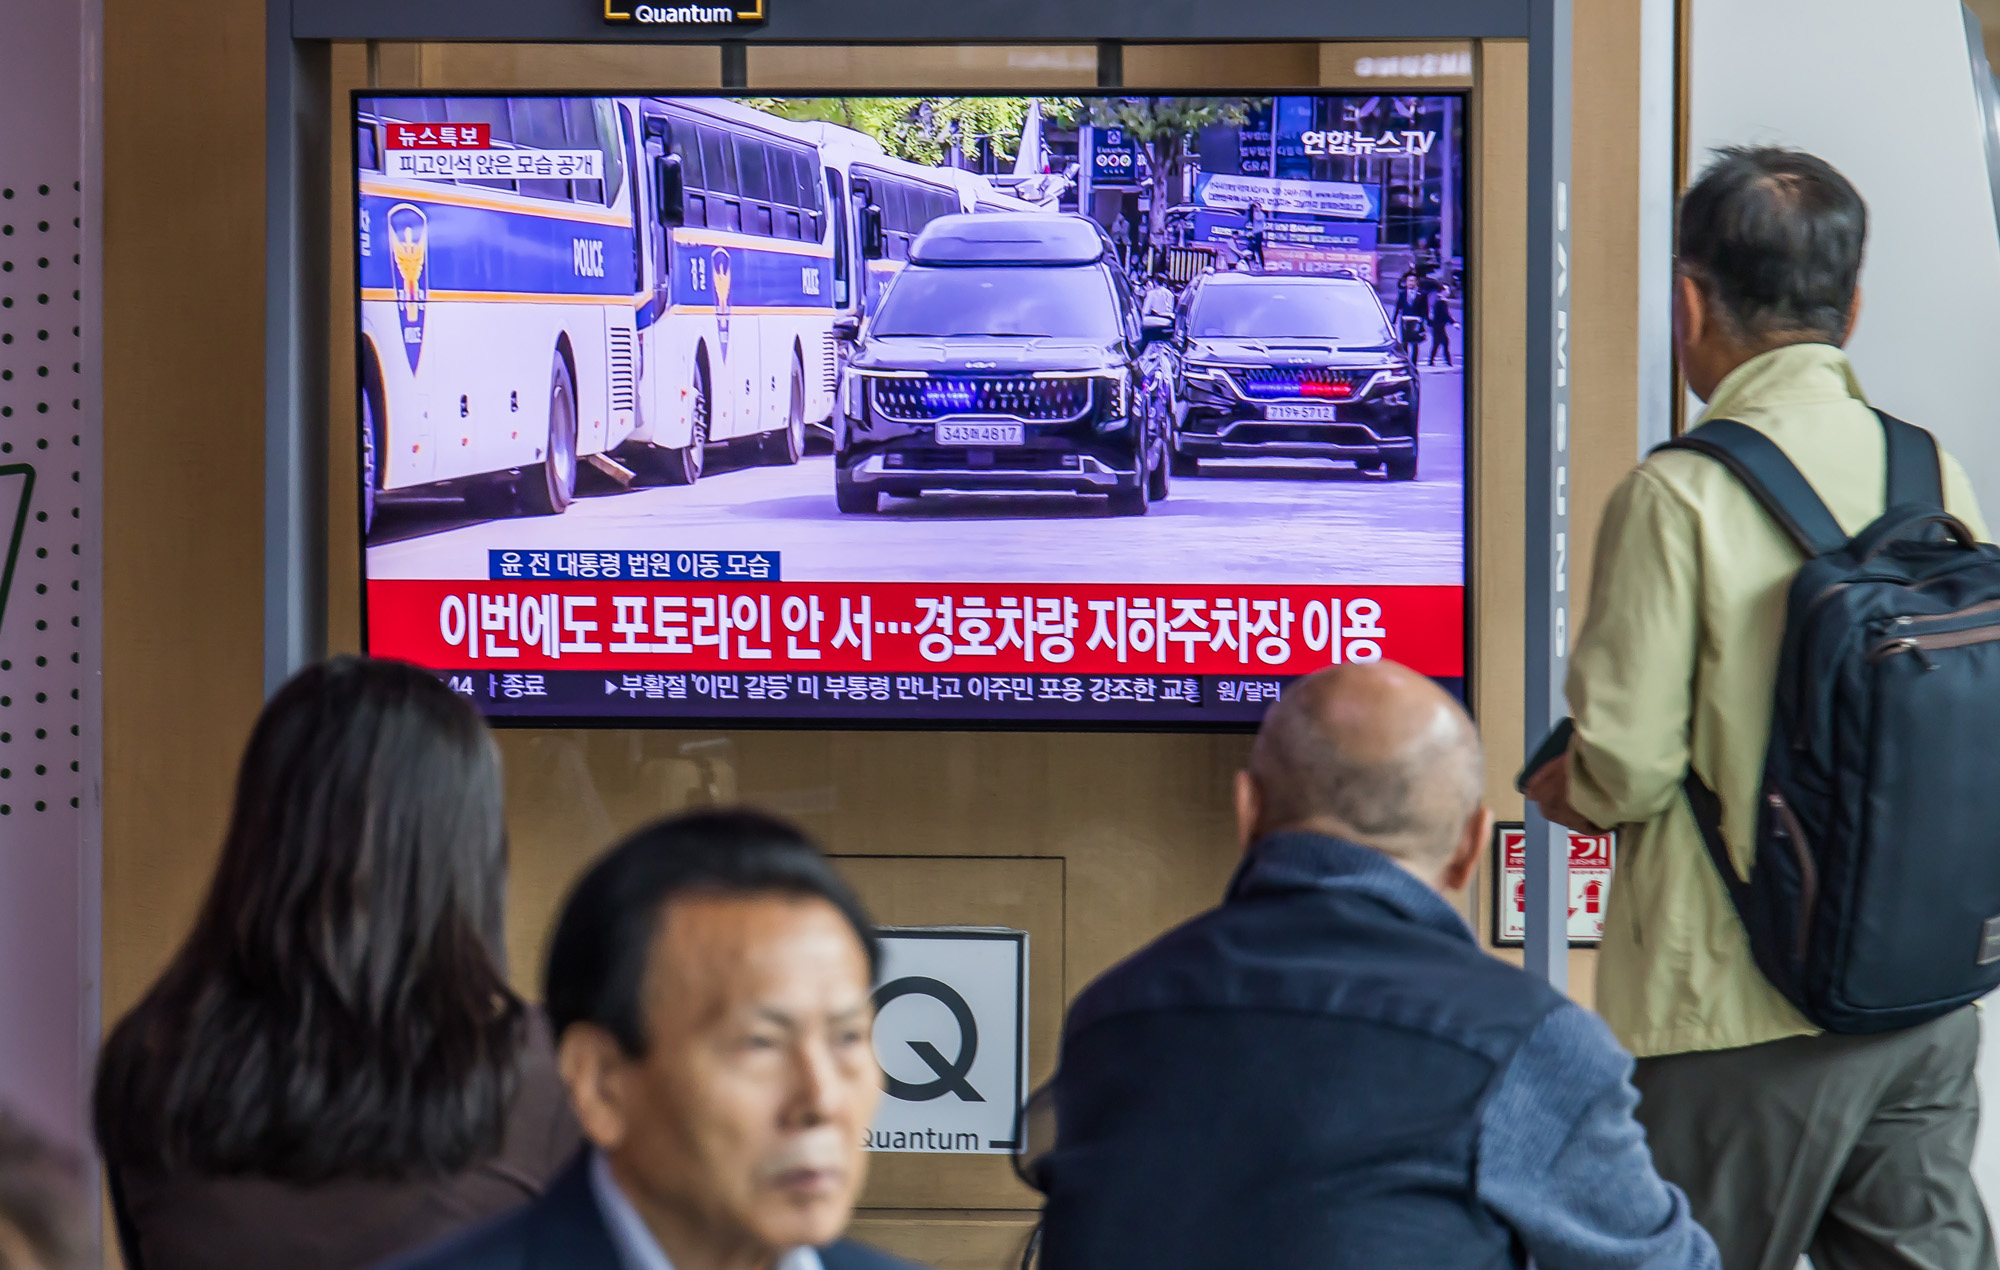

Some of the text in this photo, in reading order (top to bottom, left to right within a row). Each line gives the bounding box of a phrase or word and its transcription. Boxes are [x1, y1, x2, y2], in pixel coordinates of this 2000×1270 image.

[635, 4, 732, 23] Quantum
[398, 127, 480, 147] 뉴스특보
[1301, 130, 1437, 156] 연합뉴스TV
[399, 154, 594, 177] 피고인석 앉은 모습 공개
[573, 238, 605, 277] POLICE
[1556, 180, 1568, 658] SAMSUNG
[499, 552, 771, 579] 윤 전 대통령 법원 이동 모습
[439, 592, 603, 660] 이번에도
[609, 594, 772, 661] 포토라인
[781, 595, 825, 661] 안
[1085, 596, 1295, 665] 지하주차장
[1302, 598, 1386, 665] 이용
[501, 673, 548, 699] 종료
[620, 674, 687, 700] 부활절
[797, 675, 819, 701] 미
[823, 675, 890, 702] 부통령
[896, 676, 964, 702] 만나고
[967, 676, 1034, 703] 이주민
[1037, 677, 1084, 703] 포용
[1089, 678, 1156, 703] 강조한
[1216, 680, 1281, 703] 원/달러
[871, 976, 987, 1102] Q
